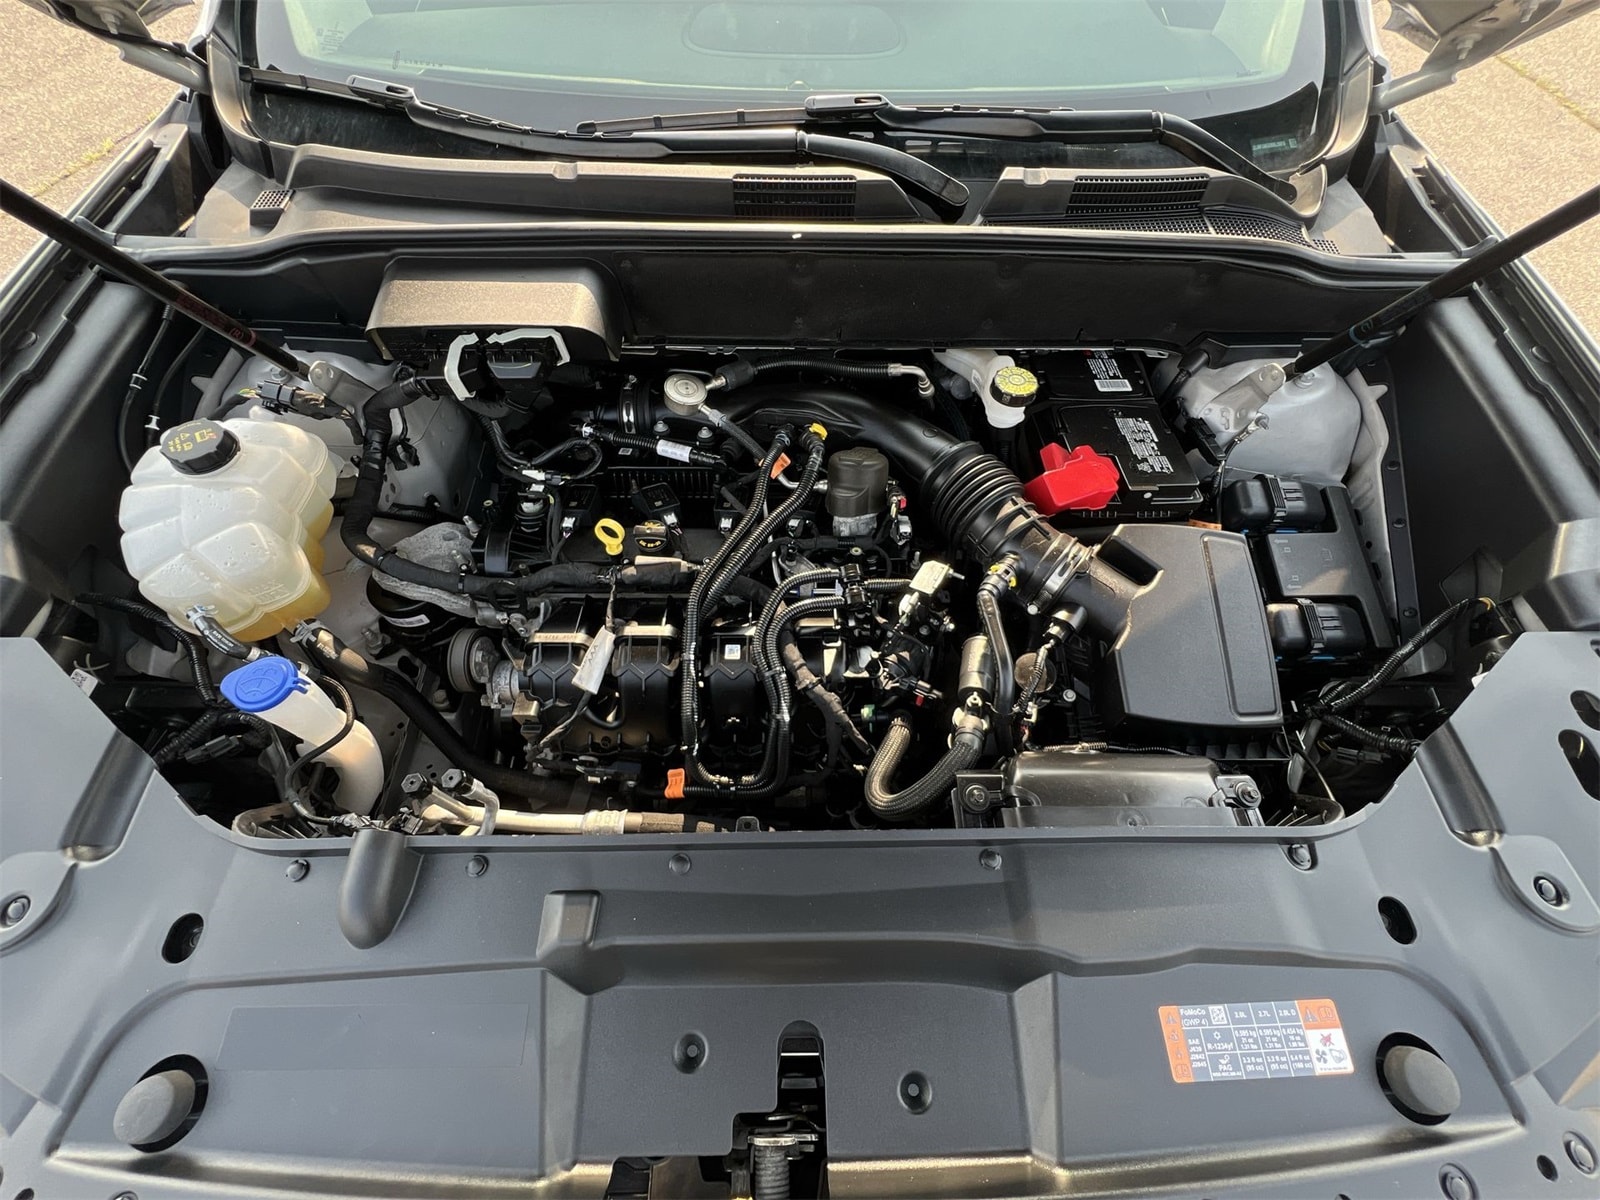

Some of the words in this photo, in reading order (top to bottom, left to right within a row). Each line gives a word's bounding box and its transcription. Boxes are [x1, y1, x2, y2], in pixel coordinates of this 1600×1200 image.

[404, 59, 443, 67] LINCOLN
[1180, 1008, 1206, 1016] FoMoCo
[1181, 1018, 1200, 1027] (GWP
[1201, 1017, 1209, 1027] 4)
[1207, 1042, 1234, 1051] R-1234yf
